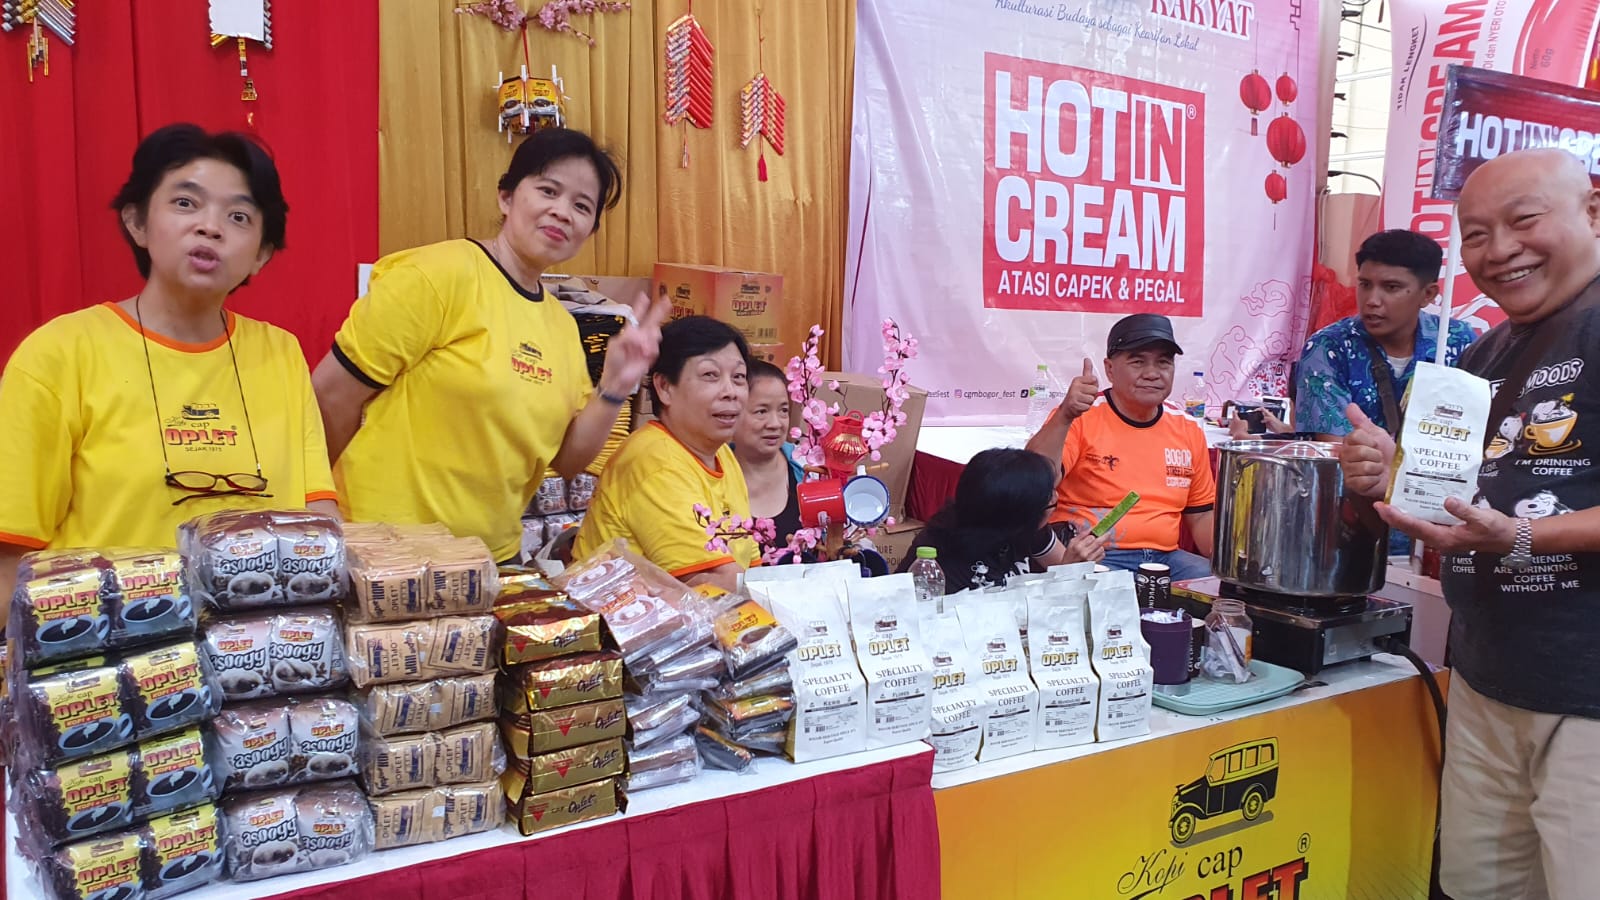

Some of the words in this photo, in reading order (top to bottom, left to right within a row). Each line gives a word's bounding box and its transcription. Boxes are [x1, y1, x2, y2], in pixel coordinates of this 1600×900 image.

[1057, 4, 1097, 27] Budaya
[1098, 16, 1133, 36] sebagai
[1134, 21, 1171, 46] Kearifan
[1488, 18, 1502, 42] NYERI
[1404, 25, 1419, 75] LENGKET
[1487, 43, 1497, 59] dan
[994, 175, 1186, 273] CREAM
[998, 270, 1050, 296] ATASI
[1055, 273, 1114, 299] CAPEK
[1118, 277, 1129, 300] &
[1134, 277, 1185, 303] PEGAL
[1526, 360, 1581, 388] MOODS
[191, 421, 210, 429] cap
[1418, 421, 1471, 442] OPLET
[165, 428, 238, 446] OPLET
[1164, 448, 1192, 467] BOGOR
[1413, 447, 1471, 462] SPECIALTY
[1535, 458, 1592, 466] DRINKING
[1419, 458, 1461, 471] COFFEE
[1532, 468, 1574, 476] COFFEE
[1452, 565, 1477, 574] COFFEE
[1493, 566, 1513, 574] ARE
[1501, 583, 1555, 593] WITHOUT
[1561, 580, 1580, 590] ME
[1513, 574, 1557, 583] COFFEE
[452, 578, 460, 602] OPLET
[33, 590, 99, 613] OPLET
[390, 588, 399, 611] OPLET
[463, 632, 475, 656] OPLET
[798, 643, 841, 661] OPLET
[868, 637, 910, 656] OPLET
[1102, 645, 1133, 660] OPLET
[390, 642, 399, 667] OPLET
[1041, 652, 1079, 667] OPLET
[875, 664, 924, 679] SPECIALTY
[982, 658, 1018, 675] OPLET
[1108, 668, 1146, 680] SPECIALTY
[140, 664, 198, 691] OPLET
[802, 671, 853, 687] SPECIALTY
[884, 676, 918, 689] COFFEE
[1046, 676, 1090, 687] SPECIALTY
[1116, 678, 1142, 690] COFFEE
[814, 684, 851, 698] COFFEE
[988, 685, 1029, 697] SPECIALTY
[1055, 686, 1085, 697] COFFEE
[54, 693, 117, 720] OPLET
[933, 698, 977, 714] SPECIALTY
[998, 695, 1026, 707] COFFEE
[943, 709, 972, 725] COFFEE
[143, 741, 201, 768] OPLET
[65, 777, 129, 804] OPLET
[567, 794, 596, 813] Oplet
[158, 826, 216, 853] OPLET
[77, 856, 140, 885] OPLET
[1117, 849, 1189, 895] Kopi
[1198, 845, 1243, 880] cap
